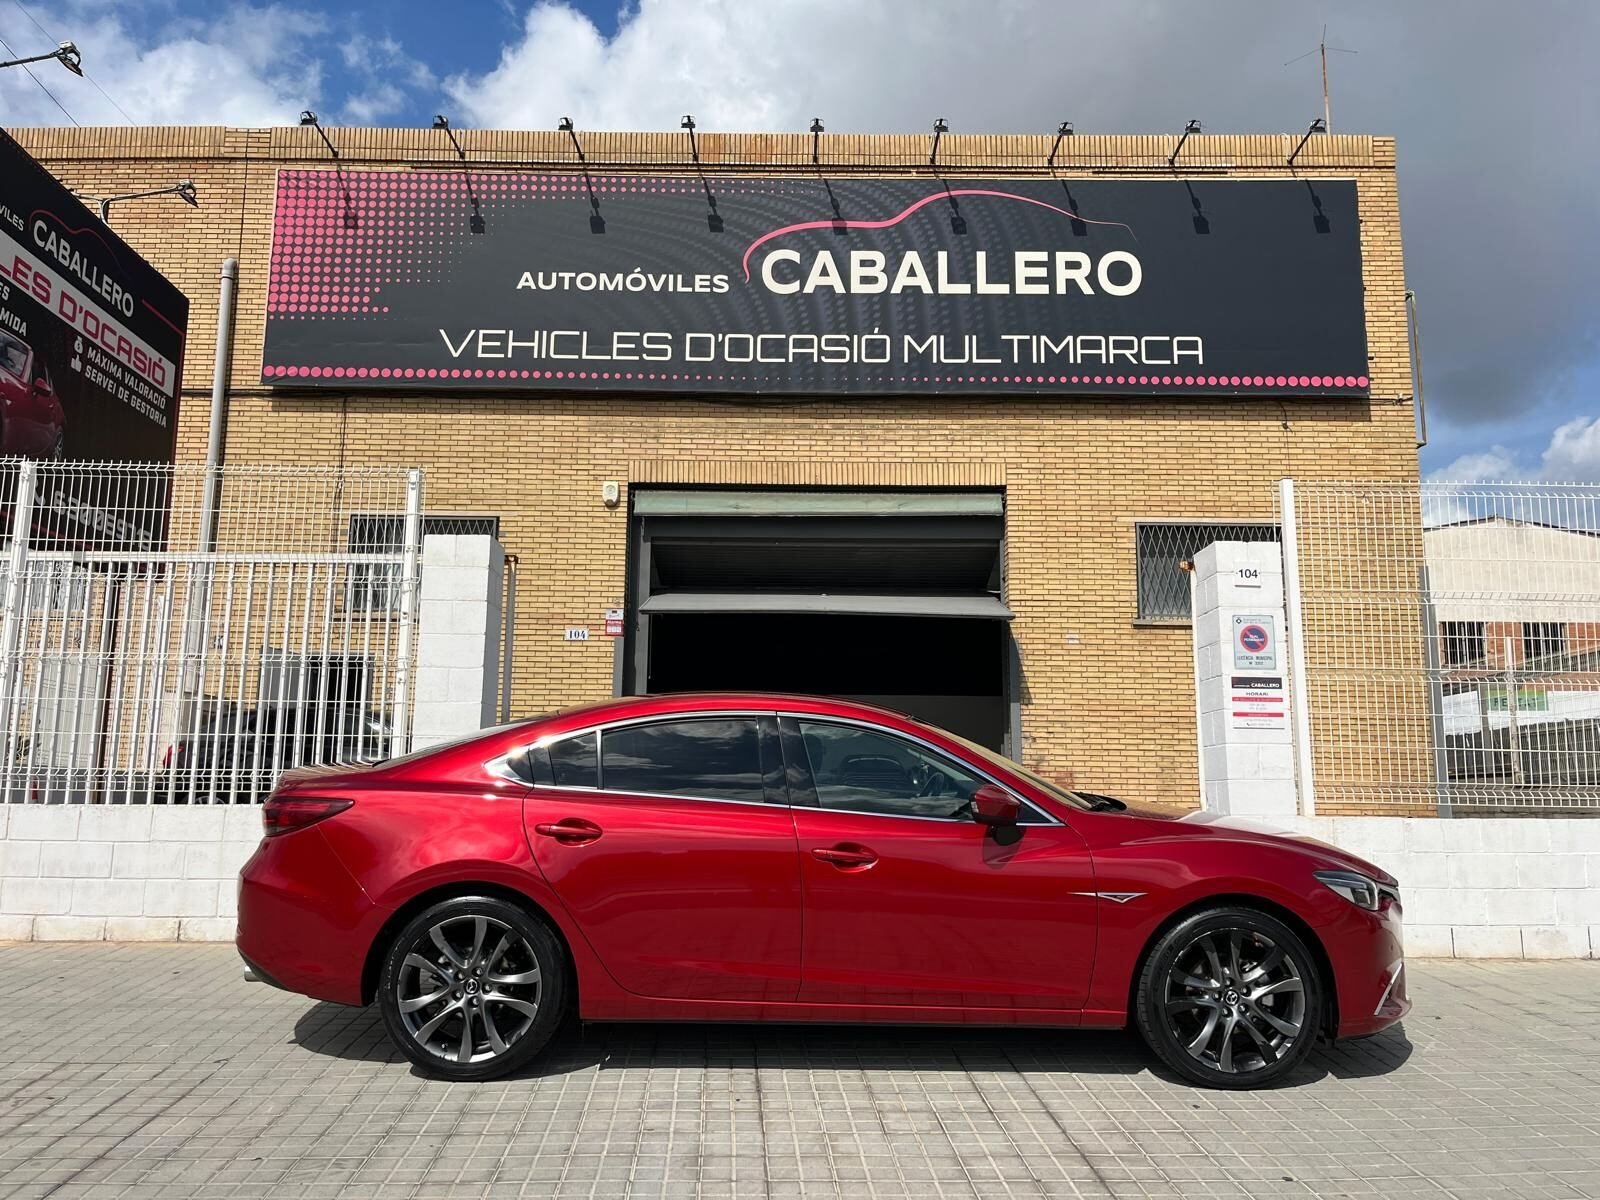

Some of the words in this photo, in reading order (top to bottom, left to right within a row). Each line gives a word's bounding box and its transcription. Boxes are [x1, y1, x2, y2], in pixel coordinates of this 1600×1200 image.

[33, 220, 134, 318] CABALLERO
[516, 267, 730, 293] AUTOMÓVILES
[761, 249, 1143, 297] CABALLERO
[0, 307, 27, 337] MIDA
[59, 289, 166, 388] D'OCASIÓ
[439, 328, 673, 361] VEHICLES
[684, 328, 891, 363] D'OCASIÓ
[903, 334, 1204, 365] MULTIMARCA
[85, 365, 117, 395] SERVEI
[118, 386, 130, 403] DE
[130, 395, 167, 428] GESTORIA
[124, 371, 167, 409] VALORACIÓ
[1238, 568, 1258, 578] 104
[569, 630, 586, 639] 104
